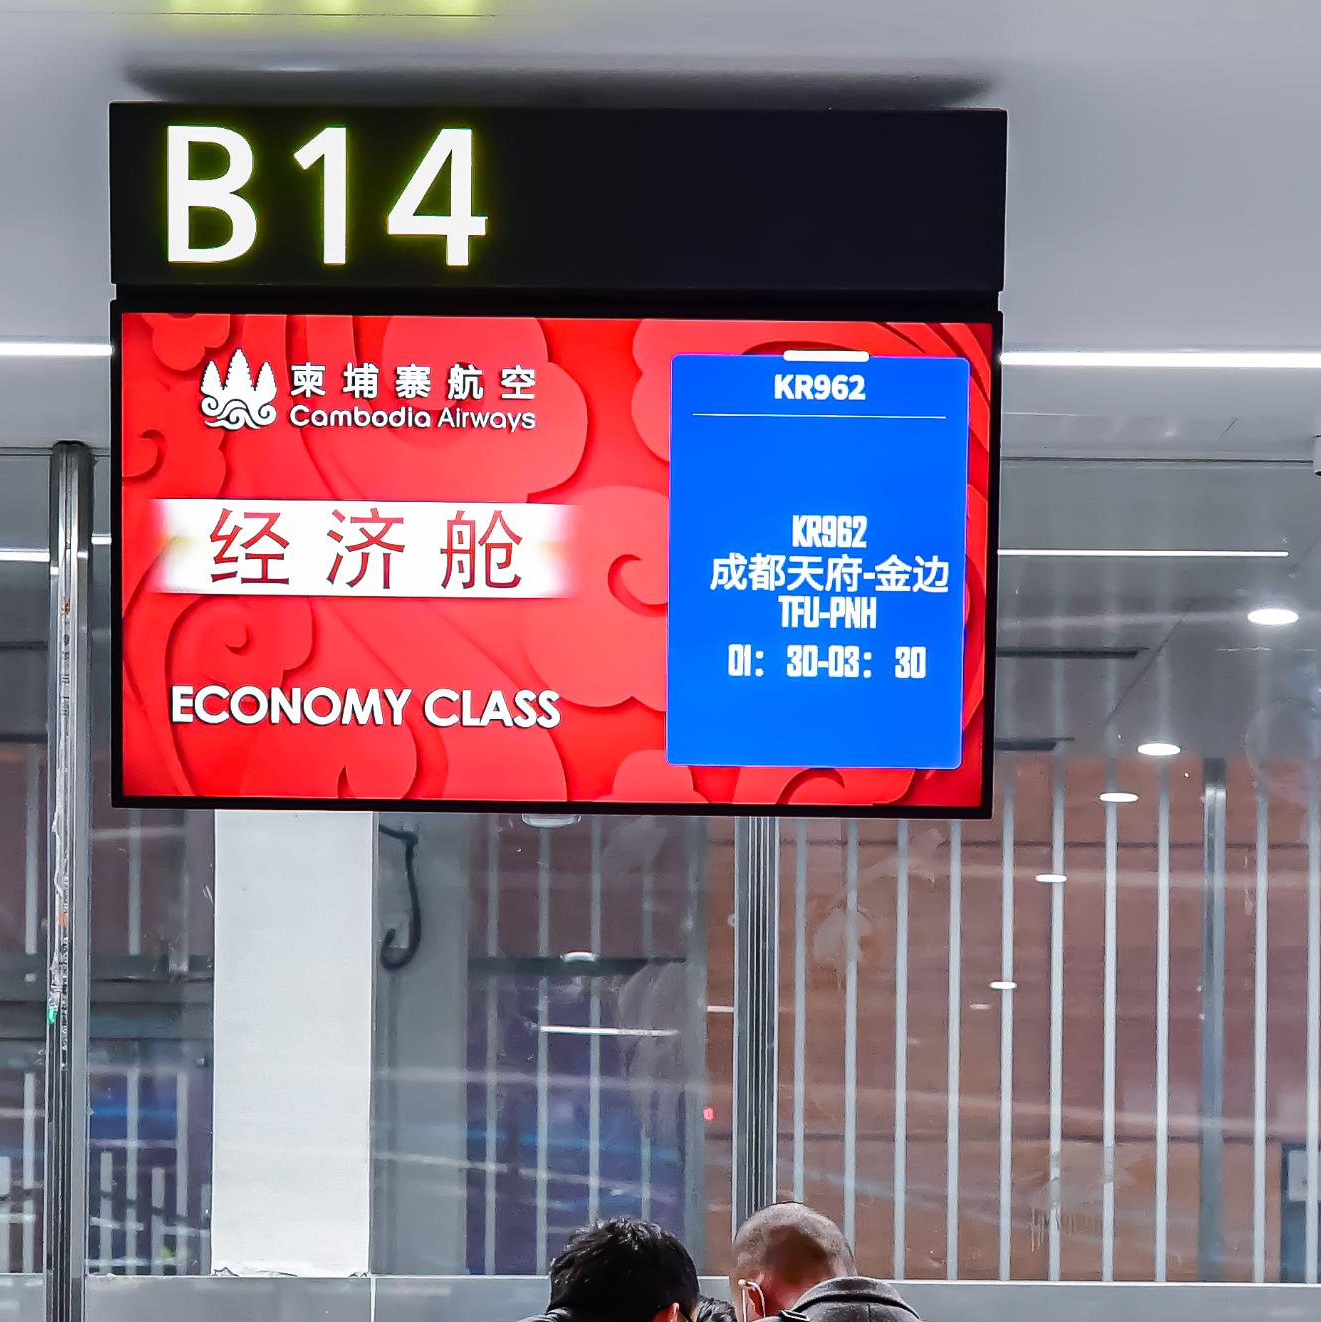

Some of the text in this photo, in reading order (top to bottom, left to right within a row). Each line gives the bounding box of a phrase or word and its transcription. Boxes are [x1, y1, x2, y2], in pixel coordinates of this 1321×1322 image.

[168, 126, 487, 265] B14
[291, 362, 535, 399] 柬埔寨航空
[775, 375, 865, 400] KR962
[290, 405, 535, 432] Cambodia Airways
[210, 508, 522, 589] 经济舱
[793, 516, 866, 547] KR962
[711, 553, 948, 592] 成都天府-金边
[779, 596, 876, 628] TFU-PNH
[173, 686, 560, 728] ECONOMY CLASS
